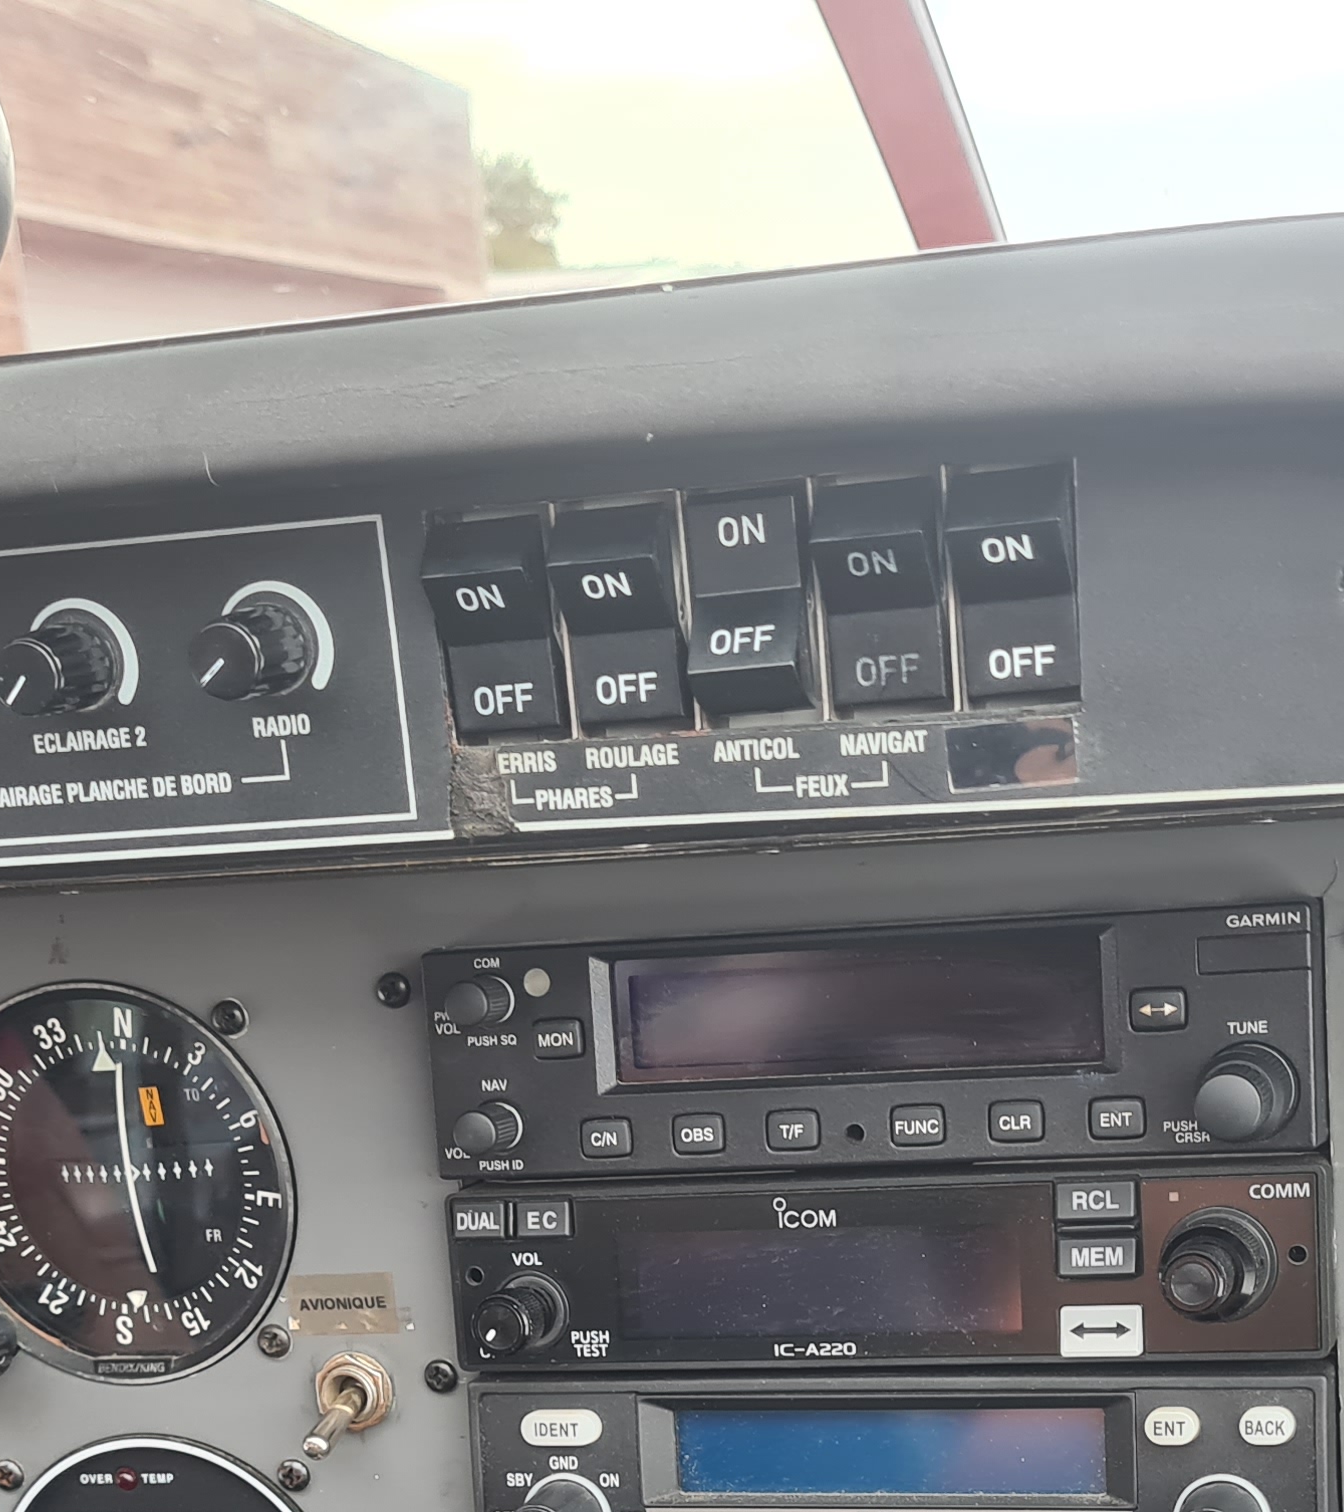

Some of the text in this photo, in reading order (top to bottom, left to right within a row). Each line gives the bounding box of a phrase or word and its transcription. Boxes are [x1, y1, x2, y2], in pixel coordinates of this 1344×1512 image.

[716, 513, 766, 548] ON
[980, 532, 1035, 565] ON
[846, 549, 899, 578] ON
[581, 571, 633, 601] ON
[456, 583, 505, 613] ON
[708, 624, 776, 655] OFF
[987, 643, 1056, 681] OFF
[595, 671, 658, 706] OFF
[472, 681, 534, 717] OFF
[252, 713, 312, 738] RADIO
[33, 727, 147, 755] ECLAIRAGE 2
[713, 735, 801, 763] ANTICOL
[840, 728, 928, 758] NAVIGAT
[584, 742, 680, 770] ROULAGE
[65, 779, 149, 804] PLANCHE
[153, 777, 176, 798] DE
[180, 772, 233, 796] BORD
[795, 771, 850, 799] FEUX
[535, 781, 614, 810] PHARES
[1225, 911, 1302, 928] GARMIN
[1226, 1020, 1269, 1035] TUNE
[537, 1032, 574, 1049] MON
[481, 1078, 508, 1092] NAV
[893, 1118, 940, 1137] FUNC
[998, 1114, 1032, 1131] CLR
[1099, 1111, 1133, 1128] ENT
[680, 1127, 714, 1144] OBS
[1248, 1182, 1311, 1200] COMM
[1071, 1191, 1120, 1211] RCL
[456, 1210, 500, 1231] DUAL
[511, 1252, 543, 1266] VOL
[1071, 1247, 1124, 1267] MEM
[299, 1294, 388, 1312] AVIONIQUE
[570, 1330, 610, 1344] PUSH
[574, 1343, 609, 1357] TEST
[773, 1342, 857, 1358] IC-A220
[534, 1422, 579, 1437] IDENT
[1152, 1420, 1186, 1437] ENT
[1243, 1420, 1286, 1436] BACK
[549, 1456, 579, 1470] GND
[79, 1473, 174, 1485] OVER TEMP
[506, 1473, 533, 1488] SBY
[599, 1473, 620, 1488] ON
